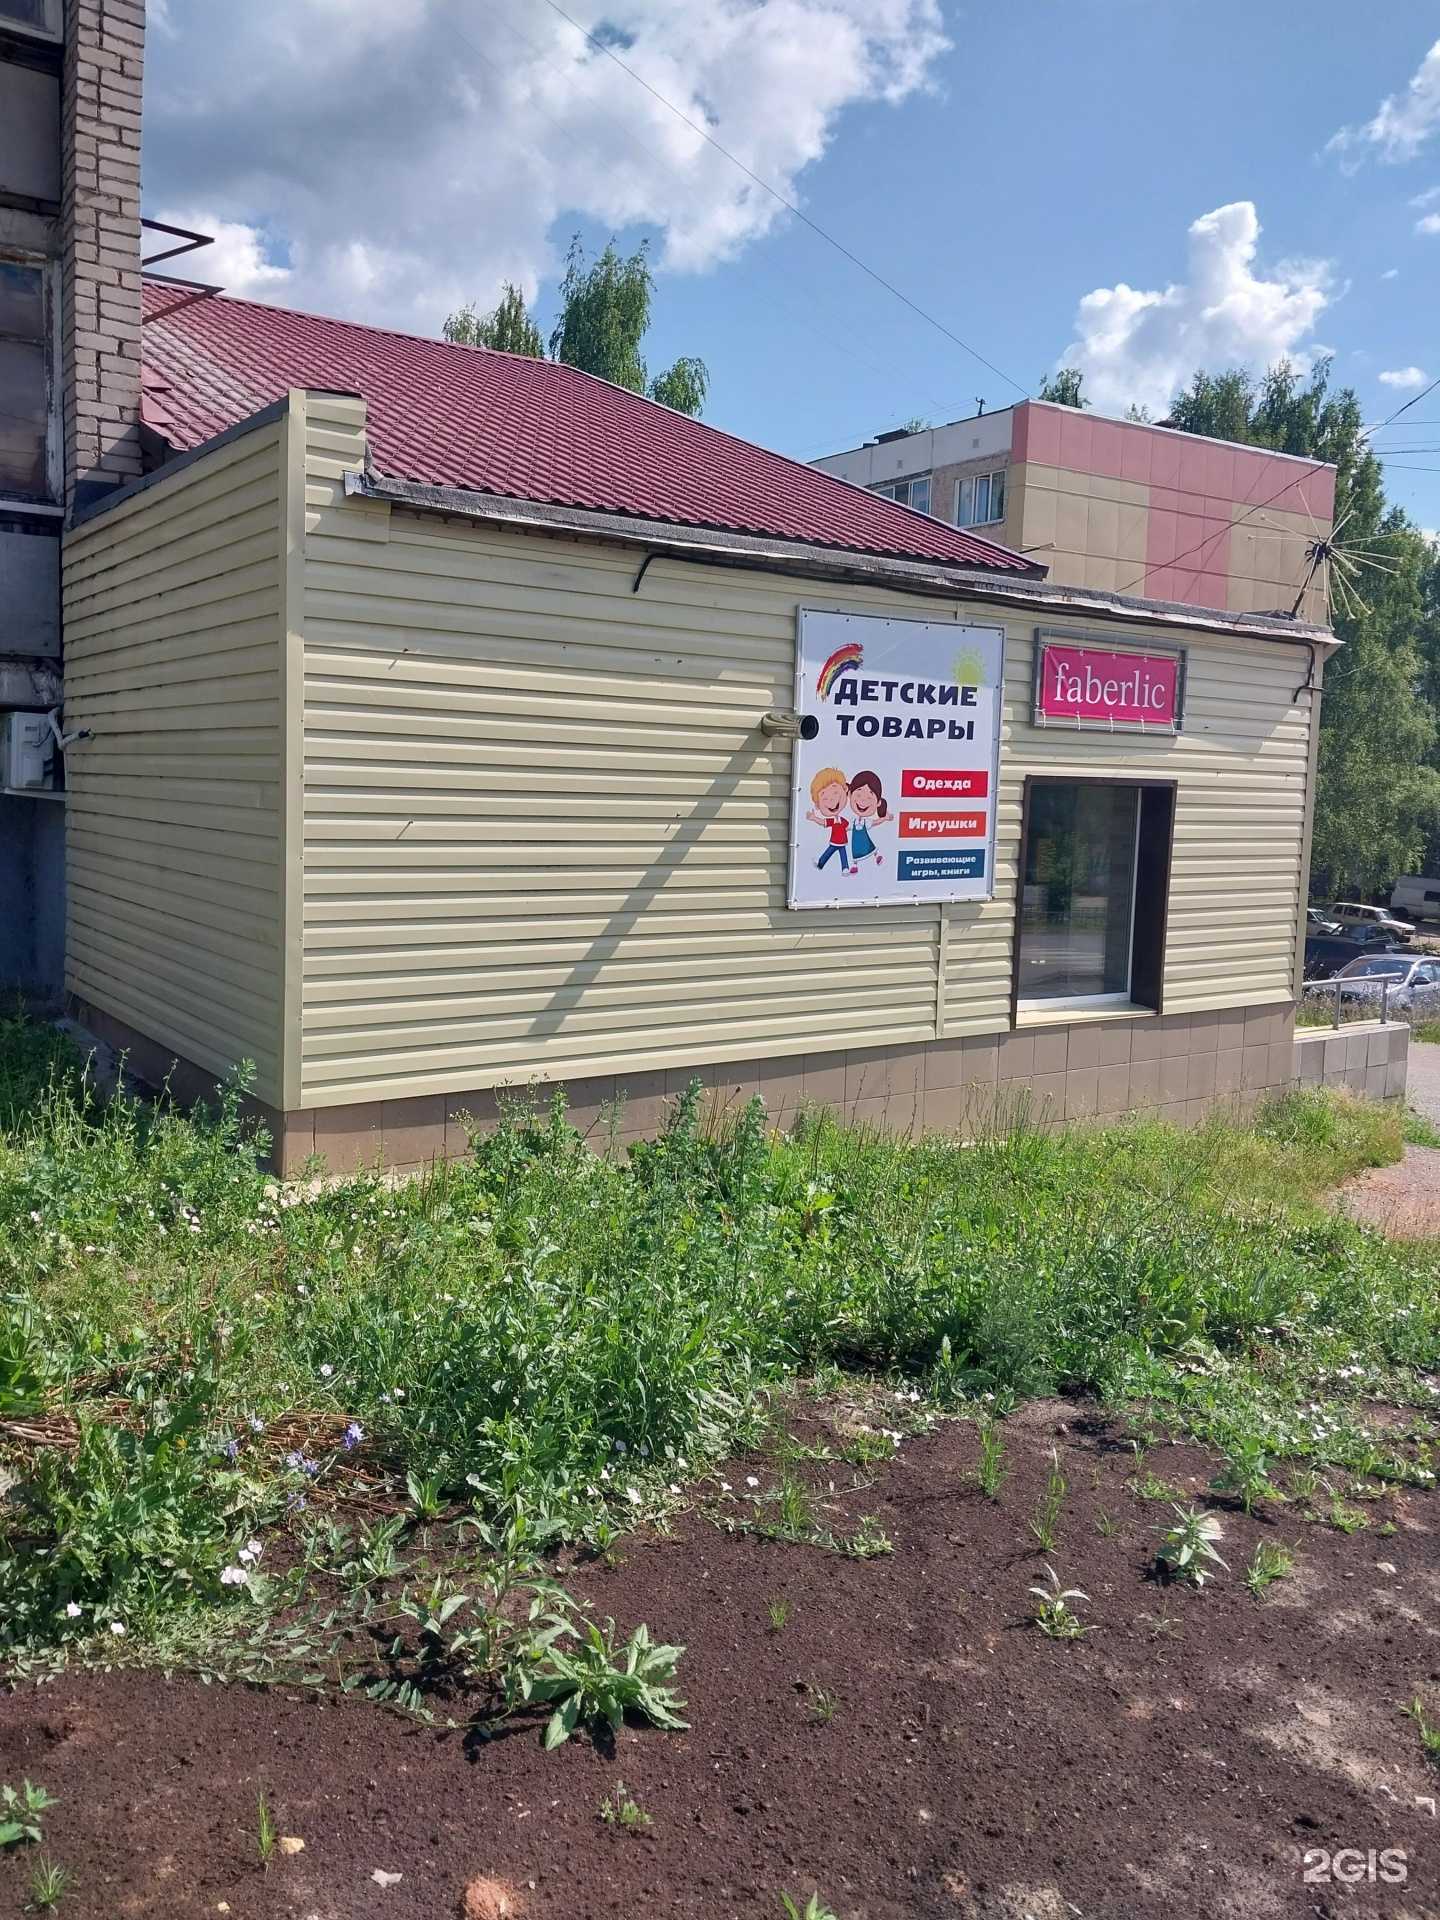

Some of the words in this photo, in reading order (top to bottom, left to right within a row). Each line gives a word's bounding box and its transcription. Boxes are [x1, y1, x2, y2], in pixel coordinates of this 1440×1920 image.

[834, 678, 978, 706] ДЕТСКИЕ
[1053, 662, 1166, 709] faberlic
[836, 714, 975, 740] ТОВАРЫ
[913, 776, 971, 790] Одежда
[908, 817, 977, 832] Игрушки
[905, 856, 976, 865] Развивающие
